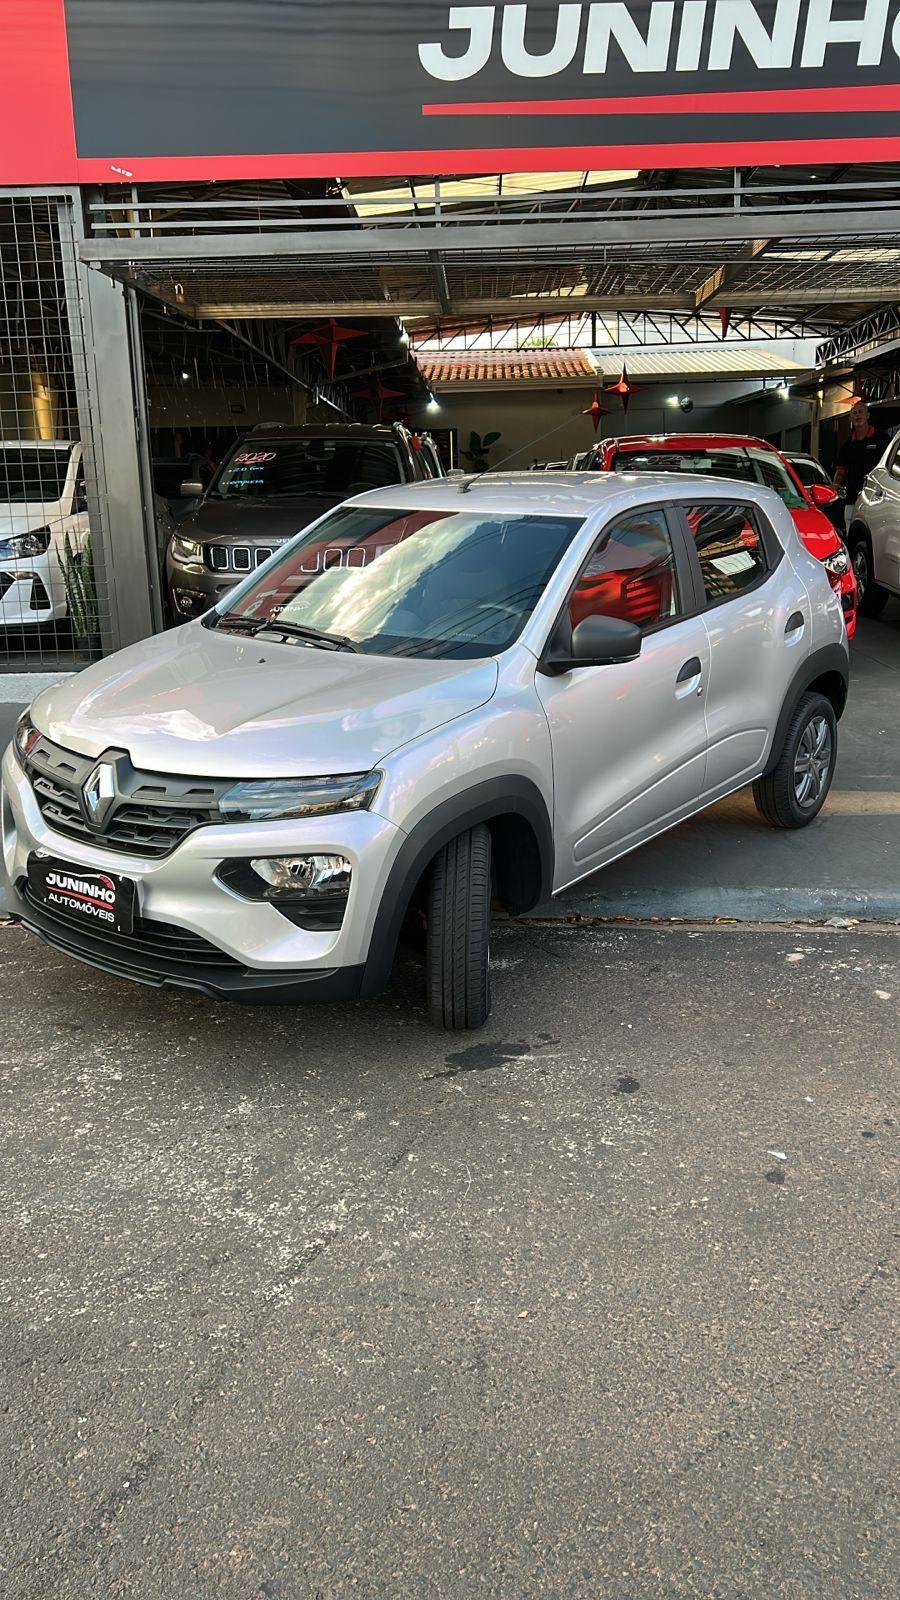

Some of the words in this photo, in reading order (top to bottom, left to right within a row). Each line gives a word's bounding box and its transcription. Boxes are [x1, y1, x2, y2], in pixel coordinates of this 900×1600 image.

[418, 0, 900, 81] JUNINH
[234, 452, 277, 462] 2020
[45, 872, 116, 903] JUNINHO
[48, 893, 115, 923] AUTOMÓVEIS
